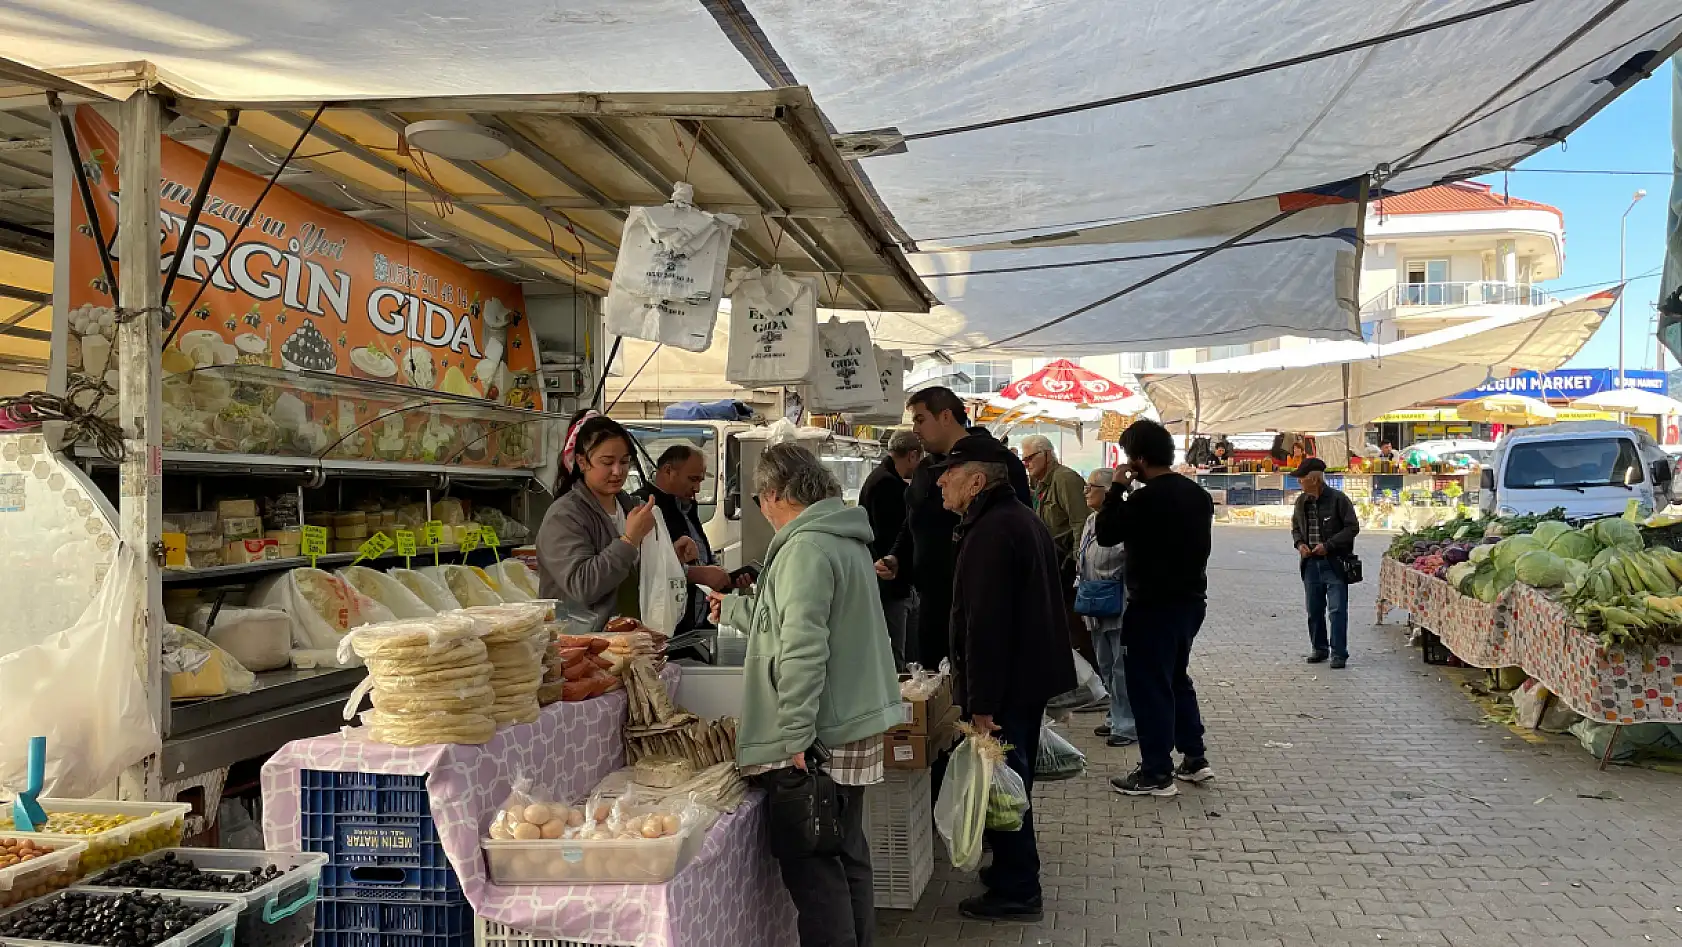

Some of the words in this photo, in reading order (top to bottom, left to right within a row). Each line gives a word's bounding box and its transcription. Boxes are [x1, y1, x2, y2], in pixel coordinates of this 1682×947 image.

[300, 222, 347, 262] Yeri
[366, 286, 482, 359] GIDA
[1530, 376, 1593, 390] MARKET
